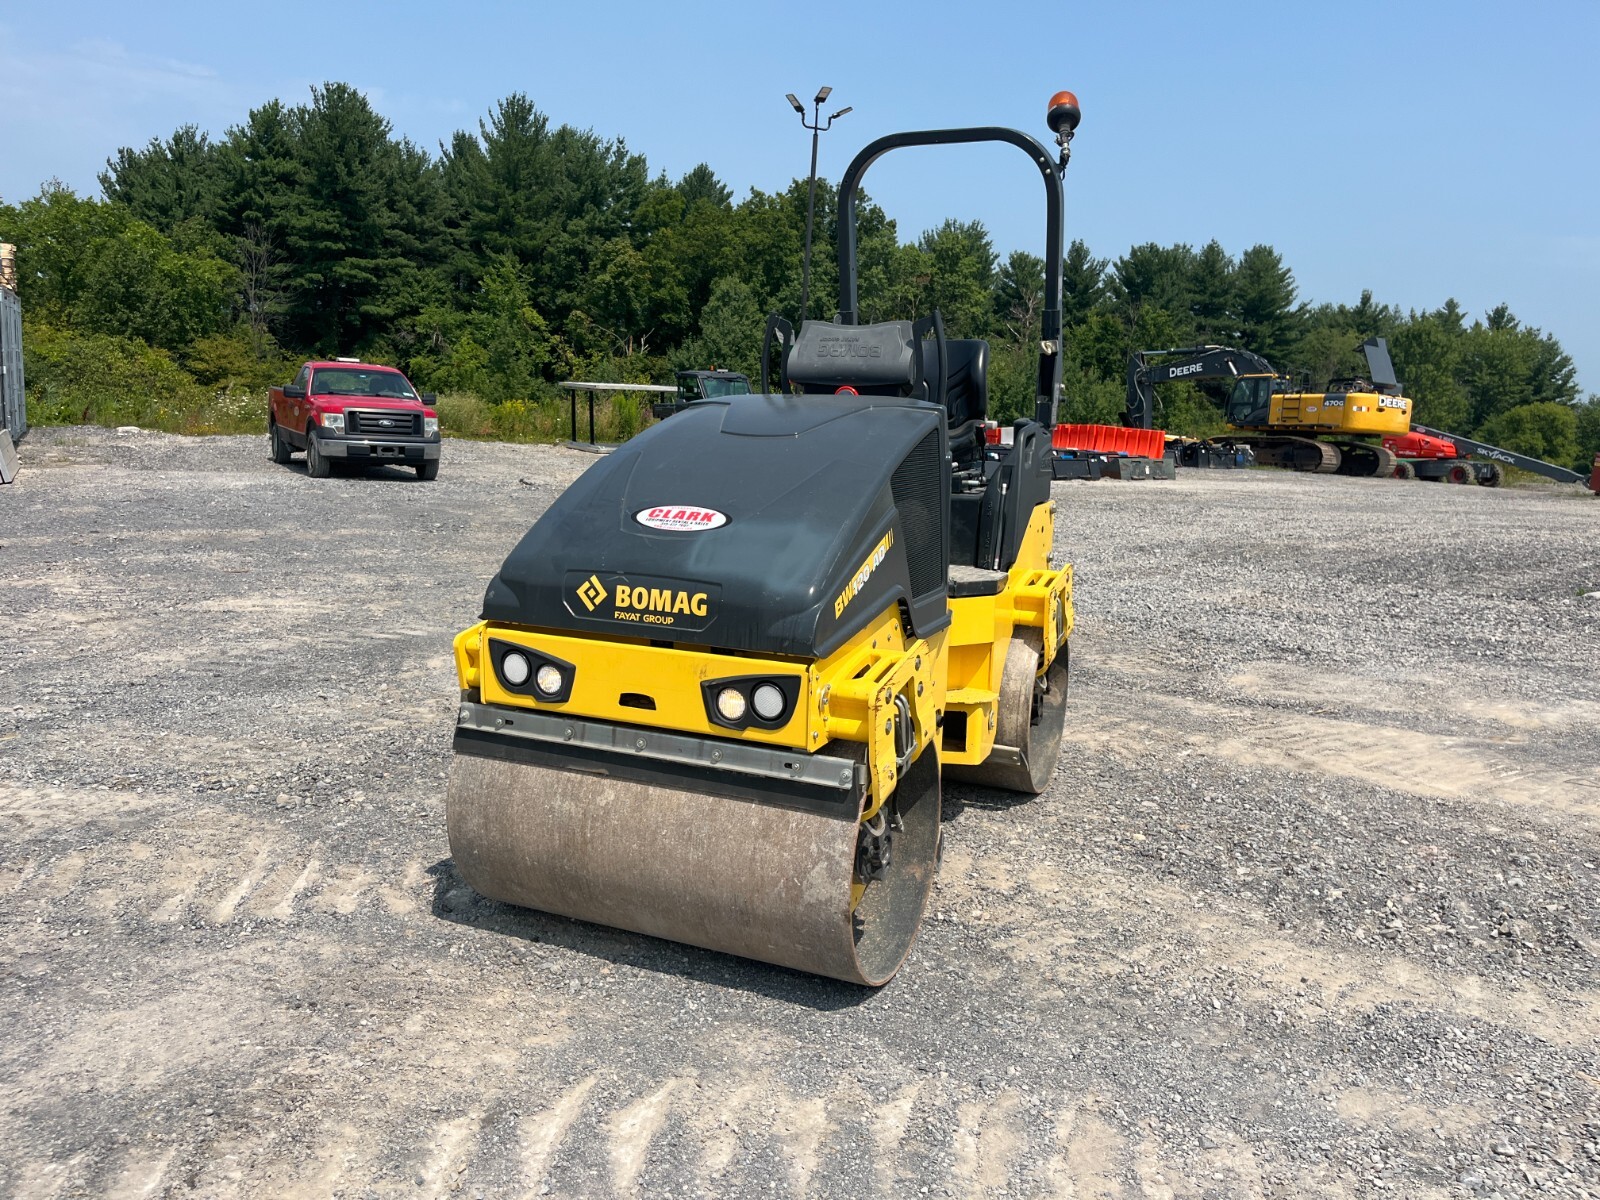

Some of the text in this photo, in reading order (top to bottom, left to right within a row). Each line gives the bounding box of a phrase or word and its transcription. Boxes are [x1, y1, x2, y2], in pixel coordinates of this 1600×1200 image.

[817, 344, 881, 358] BOMAG
[1169, 363, 1203, 378] DEERE
[1378, 395, 1407, 410] DEERE
[1477, 447, 1516, 464] SKYJACK
[648, 508, 716, 523] CLARK
[872, 545, 887, 573] AD
[615, 584, 708, 617] BOMAG
[614, 611, 674, 625] FAYAT GROUP
